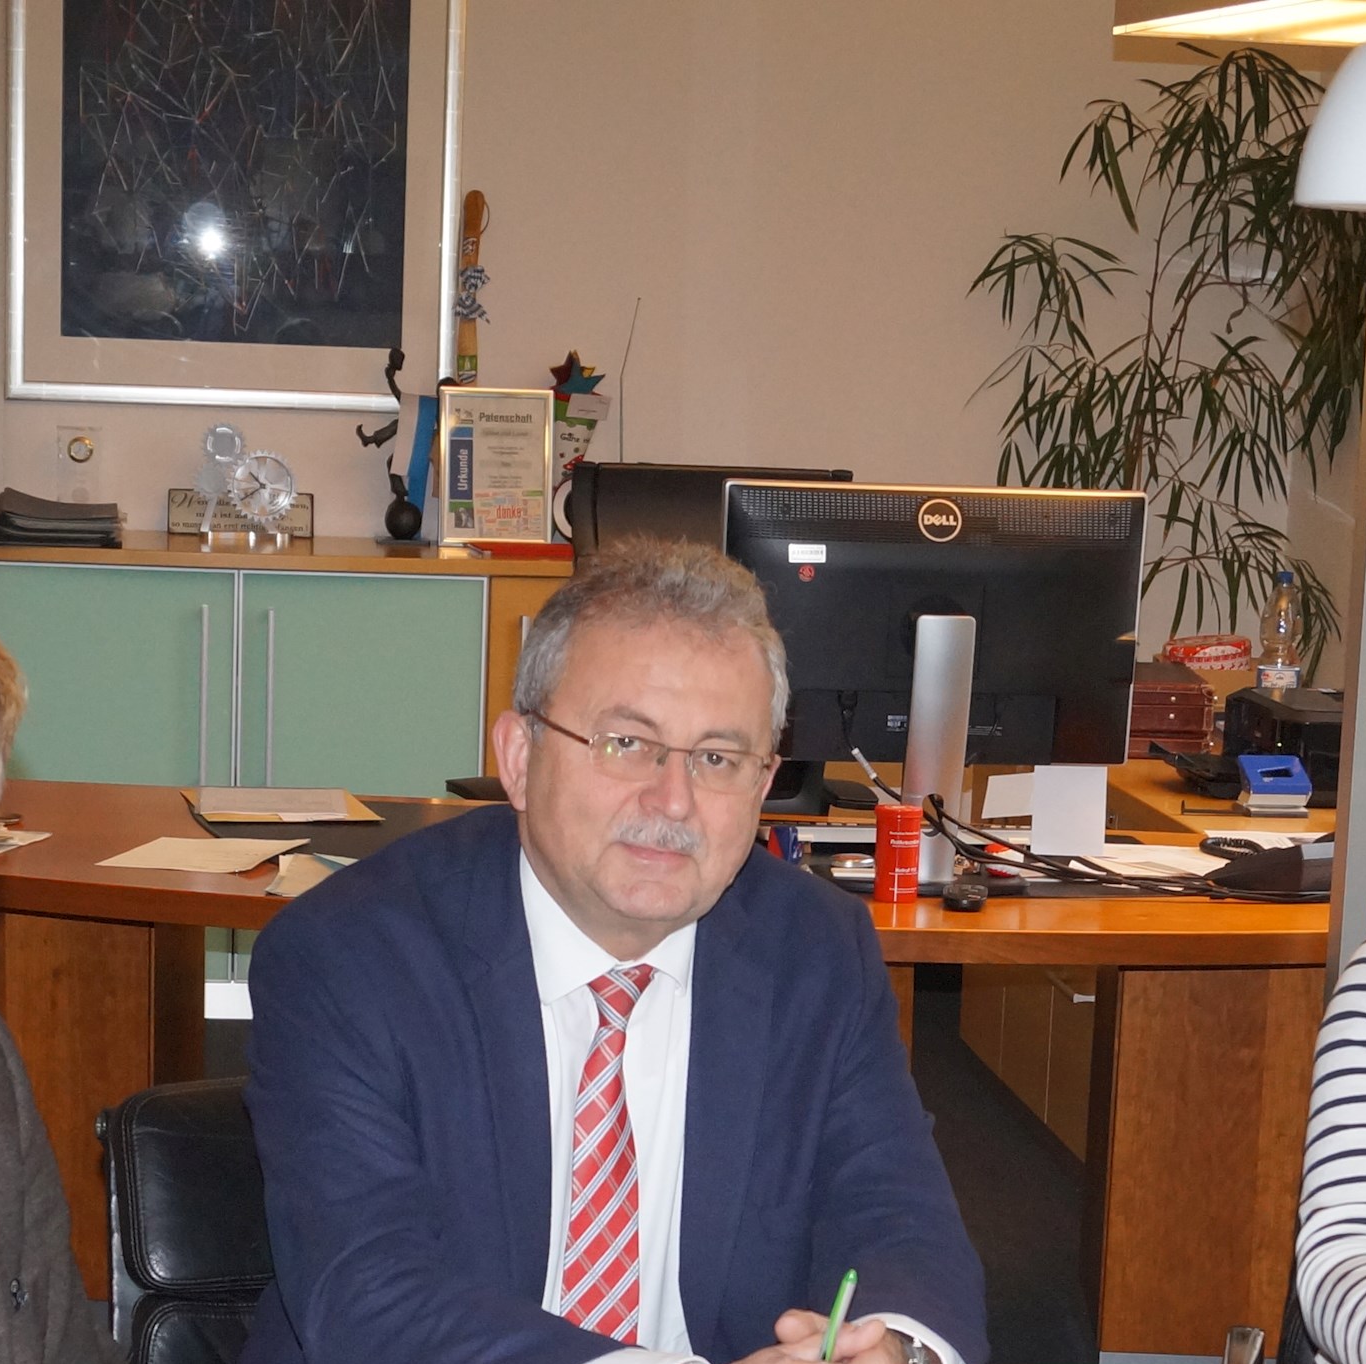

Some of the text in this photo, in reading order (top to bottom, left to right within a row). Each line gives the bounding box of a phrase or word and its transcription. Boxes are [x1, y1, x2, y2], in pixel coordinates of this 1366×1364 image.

[479, 412, 533, 424] Patenschaft
[457, 448, 469, 491] Urkunde
[496, 505, 522, 518] danke
[923, 514, 957, 526] DELL
